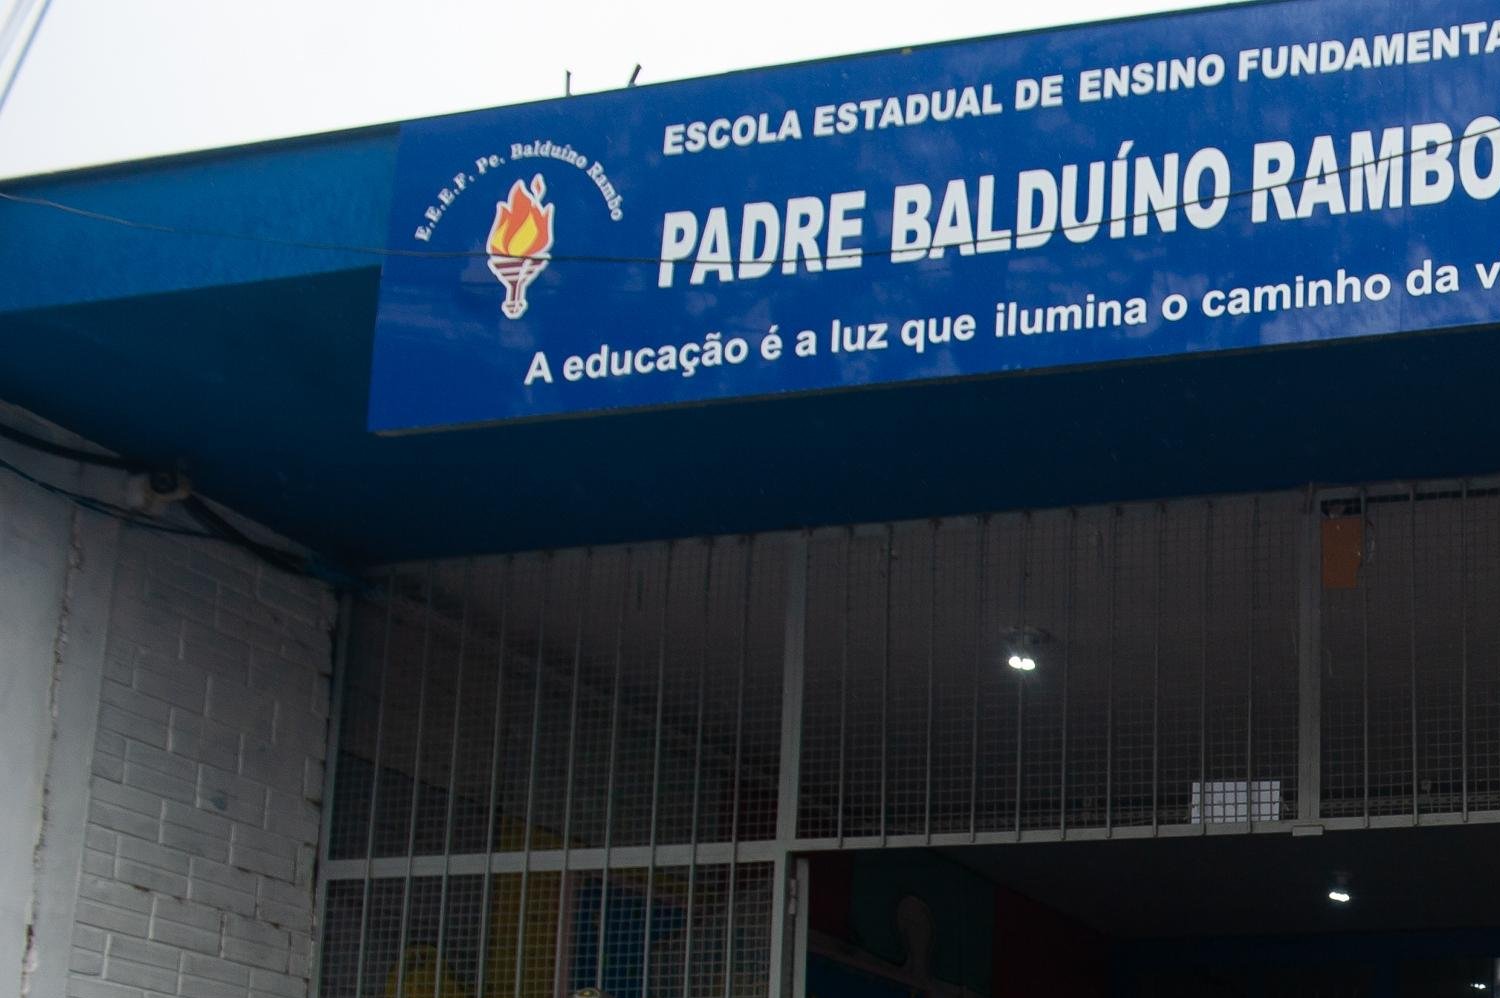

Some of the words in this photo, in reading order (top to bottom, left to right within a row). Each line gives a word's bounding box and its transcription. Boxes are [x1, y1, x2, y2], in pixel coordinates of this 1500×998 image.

[663, 109, 803, 156] ESCOLA
[813, 84, 1003, 136] ESTADUAL
[1014, 74, 1064, 111] DE
[1079, 53, 1225, 103] ENSINO
[414, 172, 475, 241] E.E.E.F.
[475, 154, 507, 175] Pe.
[586, 161, 624, 221] Rambo
[658, 190, 872, 288] PADRE
[890, 139, 1232, 263] BALDUÍNO
[524, 351, 553, 385] A
[563, 332, 749, 381] educação
[760, 324, 783, 360] é
[795, 330, 817, 357] a
[831, 319, 890, 353] luz
[900, 314, 977, 353] que
[994, 297, 1148, 337] ilumina
[1161, 293, 1188, 321] o
[1201, 268, 1392, 317] caminho
[1405, 258, 1460, 297] da
